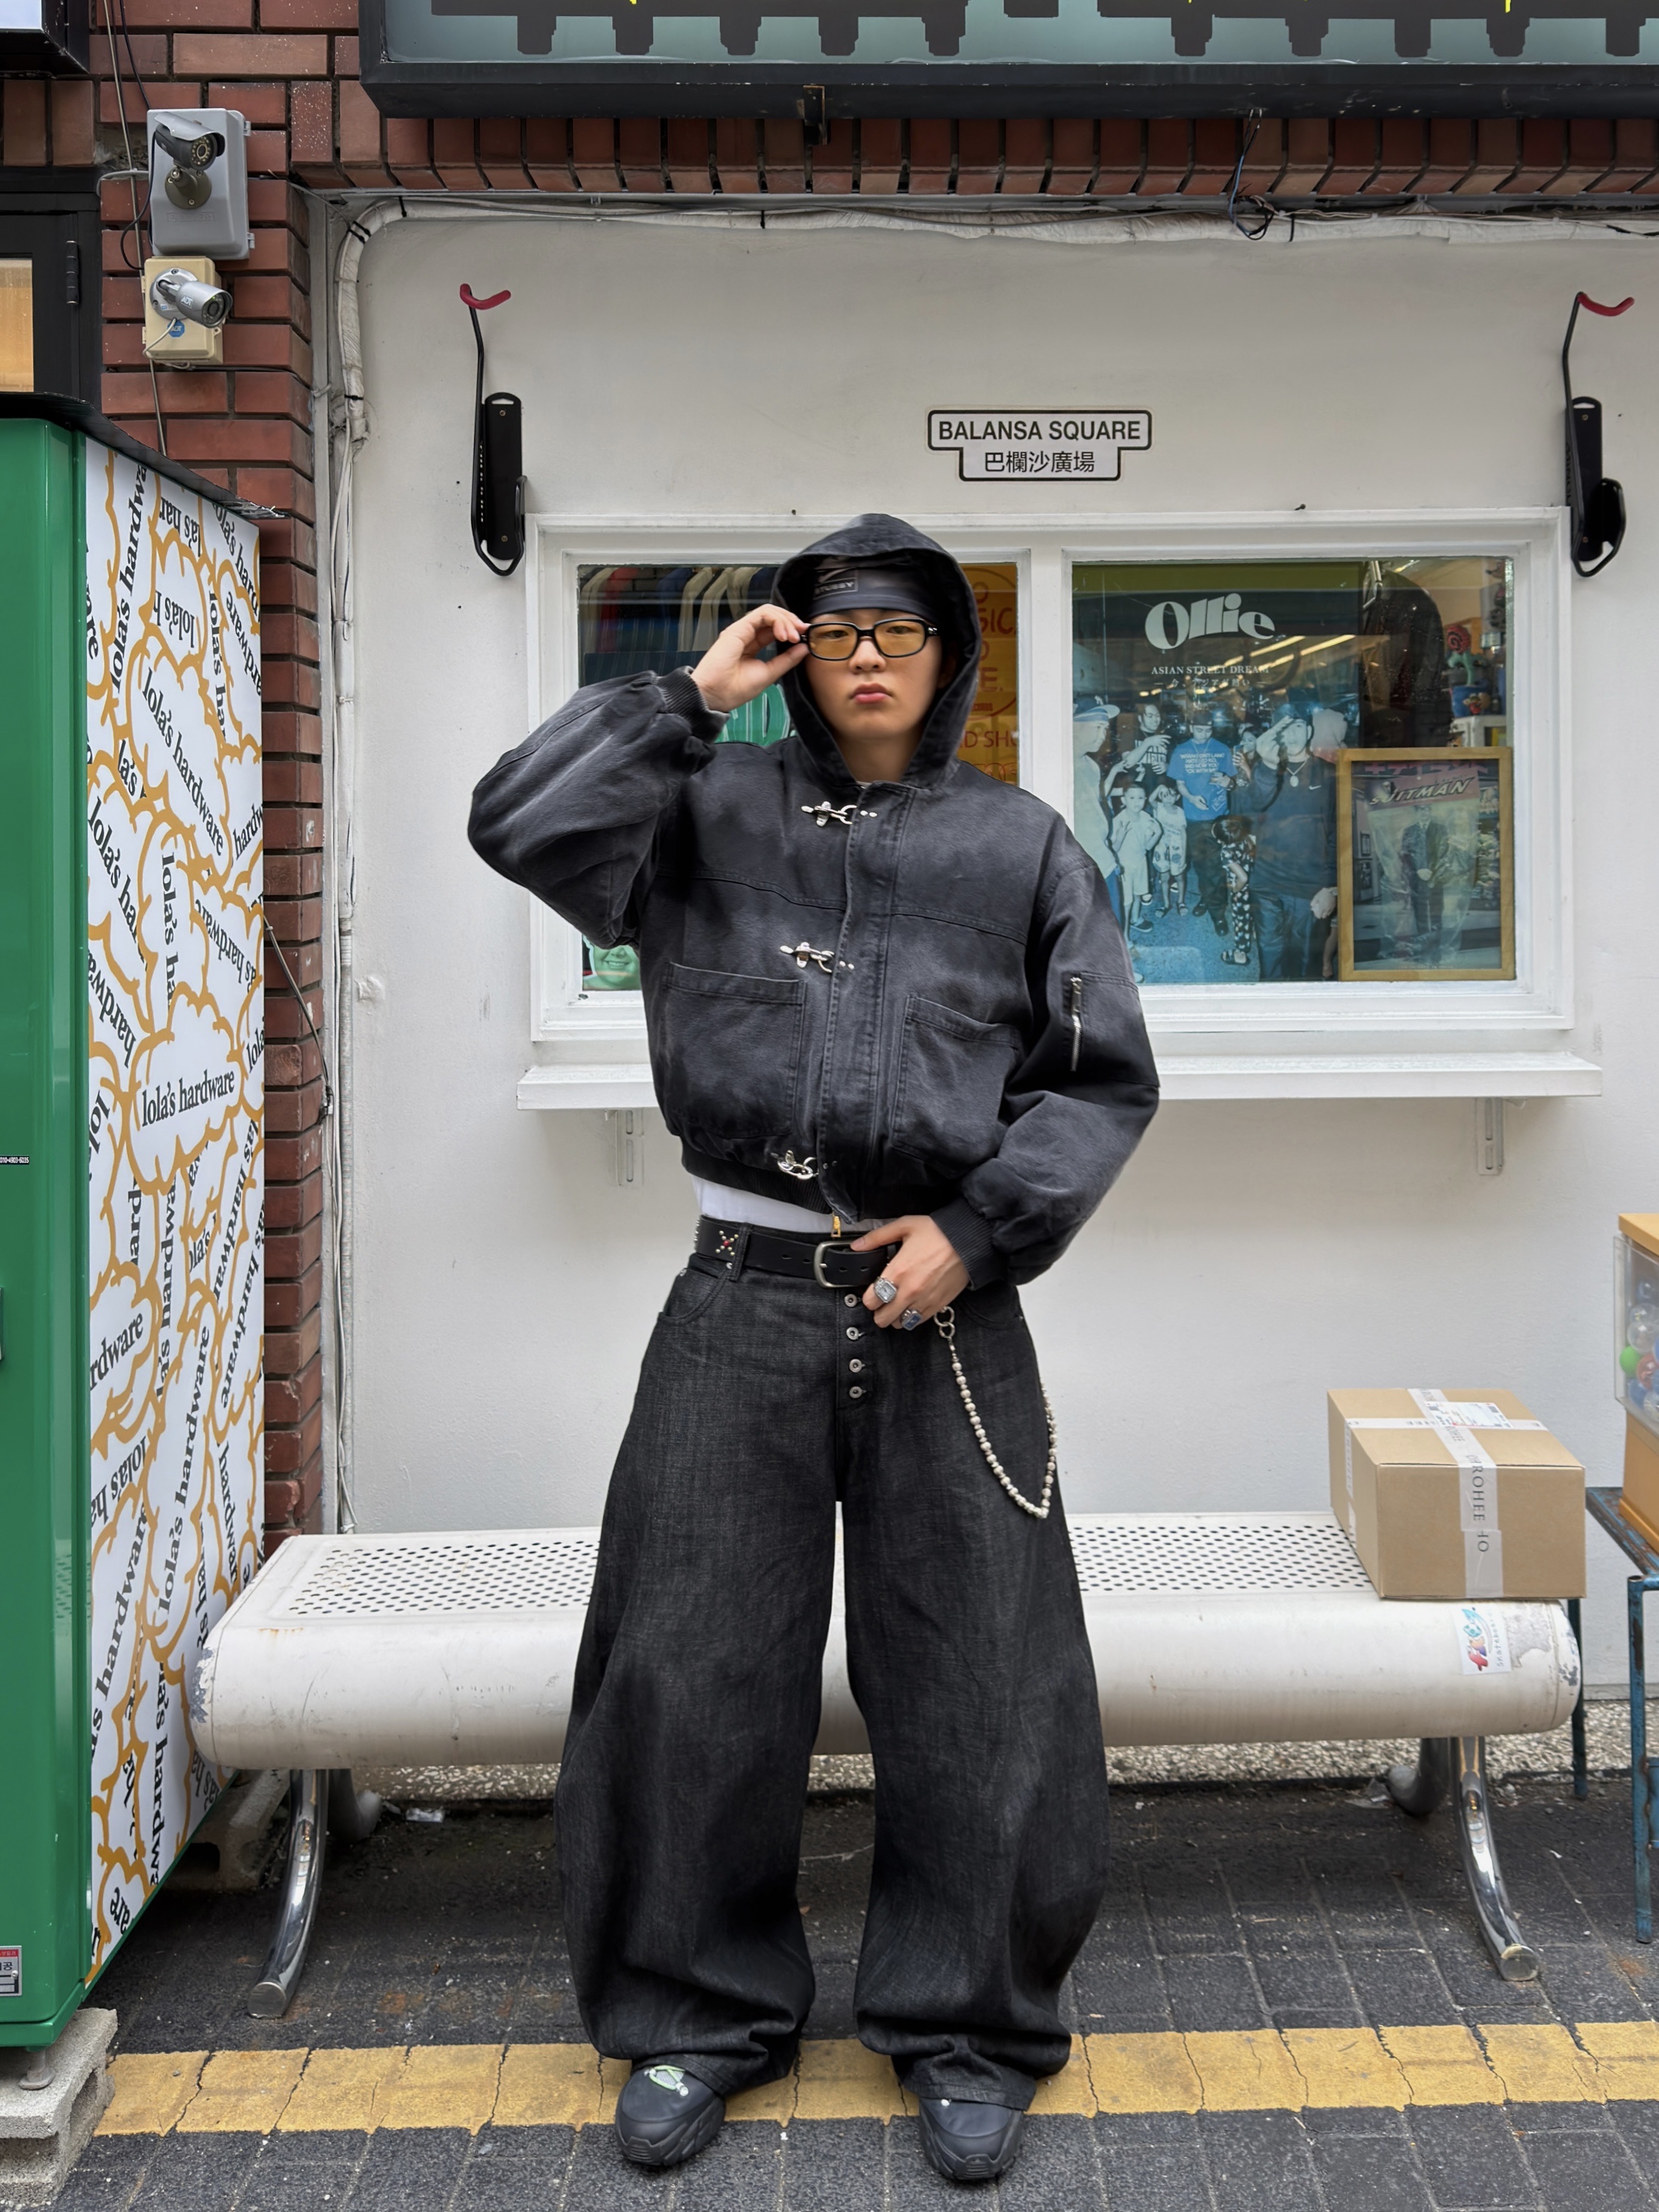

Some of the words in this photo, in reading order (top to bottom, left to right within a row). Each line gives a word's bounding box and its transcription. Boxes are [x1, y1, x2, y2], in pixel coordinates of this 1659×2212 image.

[181, 296, 193, 306] ADT
[939, 421, 1043, 440] BALANSA
[1048, 421, 1141, 441] SQUARE
[985, 451, 1095, 473] 巴欄沙廣場
[164, 597, 196, 648] lola's
[1145, 593, 1275, 649] Ollie
[1186, 666, 1227, 674] STREET
[1230, 666, 1269, 674] DREAM
[141, 666, 174, 747] lola's
[172, 731, 224, 856] hardware
[88, 795, 121, 889] lola's
[162, 851, 178, 946] lola's
[141, 1081, 176, 1127] lola's
[178, 1069, 234, 1113] hardware
[220, 1249, 260, 1408] hardware
[157, 1516, 184, 1614] lola's
[174, 1326, 210, 1509] hardware
